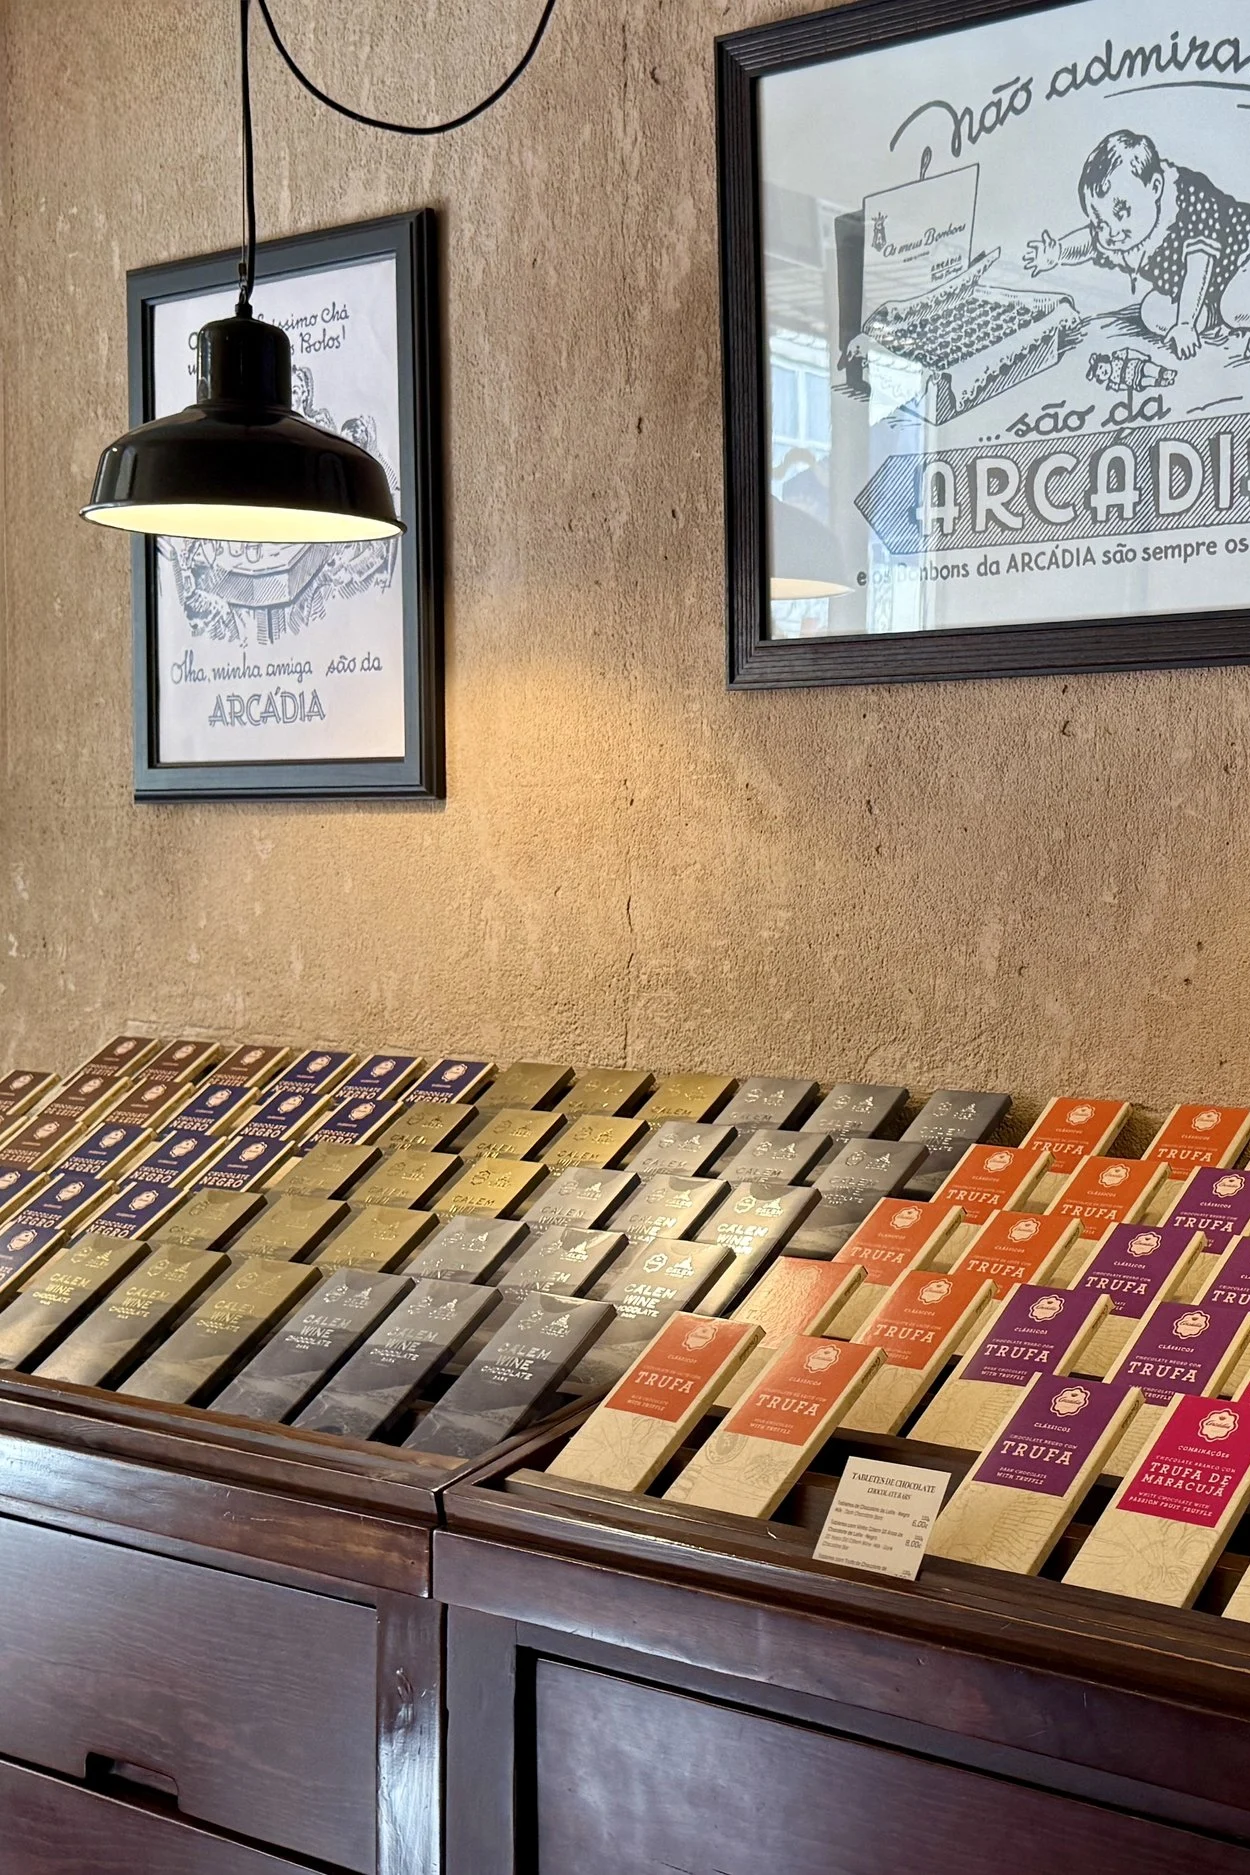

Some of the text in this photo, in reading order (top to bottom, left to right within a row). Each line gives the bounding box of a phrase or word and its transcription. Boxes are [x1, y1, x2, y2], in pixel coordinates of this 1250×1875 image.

[890, 76, 1033, 157] Não
[320, 301, 349, 323] Chá
[1101, 388, 1171, 428] da
[856, 571, 867, 586] e
[977, 554, 1000, 577] da
[1006, 545, 1096, 574] ARCÁDIA
[1102, 543, 1137, 564] são
[1141, 538, 1217, 563] sempre
[1224, 536, 1250, 554] os
[212, 652, 262, 681] minha
[266, 658, 313, 683] amiga
[325, 655, 357, 677] são
[360, 652, 382, 672] da
[208, 686, 326, 727] ARCÁDIA
[1032, 1142, 1085, 1155] TRUFA
[1158, 1148, 1213, 1163] TRUFA
[1061, 1204, 1118, 1220] TRUFA
[1173, 1216, 1234, 1233] TRUFA
[966, 1260, 1025, 1279] TRUFA
[874, 1324, 935, 1344] TRUFA
[635, 1371, 695, 1394] TRUFA
[1127, 1362, 1198, 1382] TRUFA
[755, 1394, 821, 1417] TRUFA
[1000, 1440, 1073, 1466] TRUFA
[1150, 1461, 1232, 1486] TRUFA DE
[1142, 1473, 1224, 1498] MARACUJÁ
